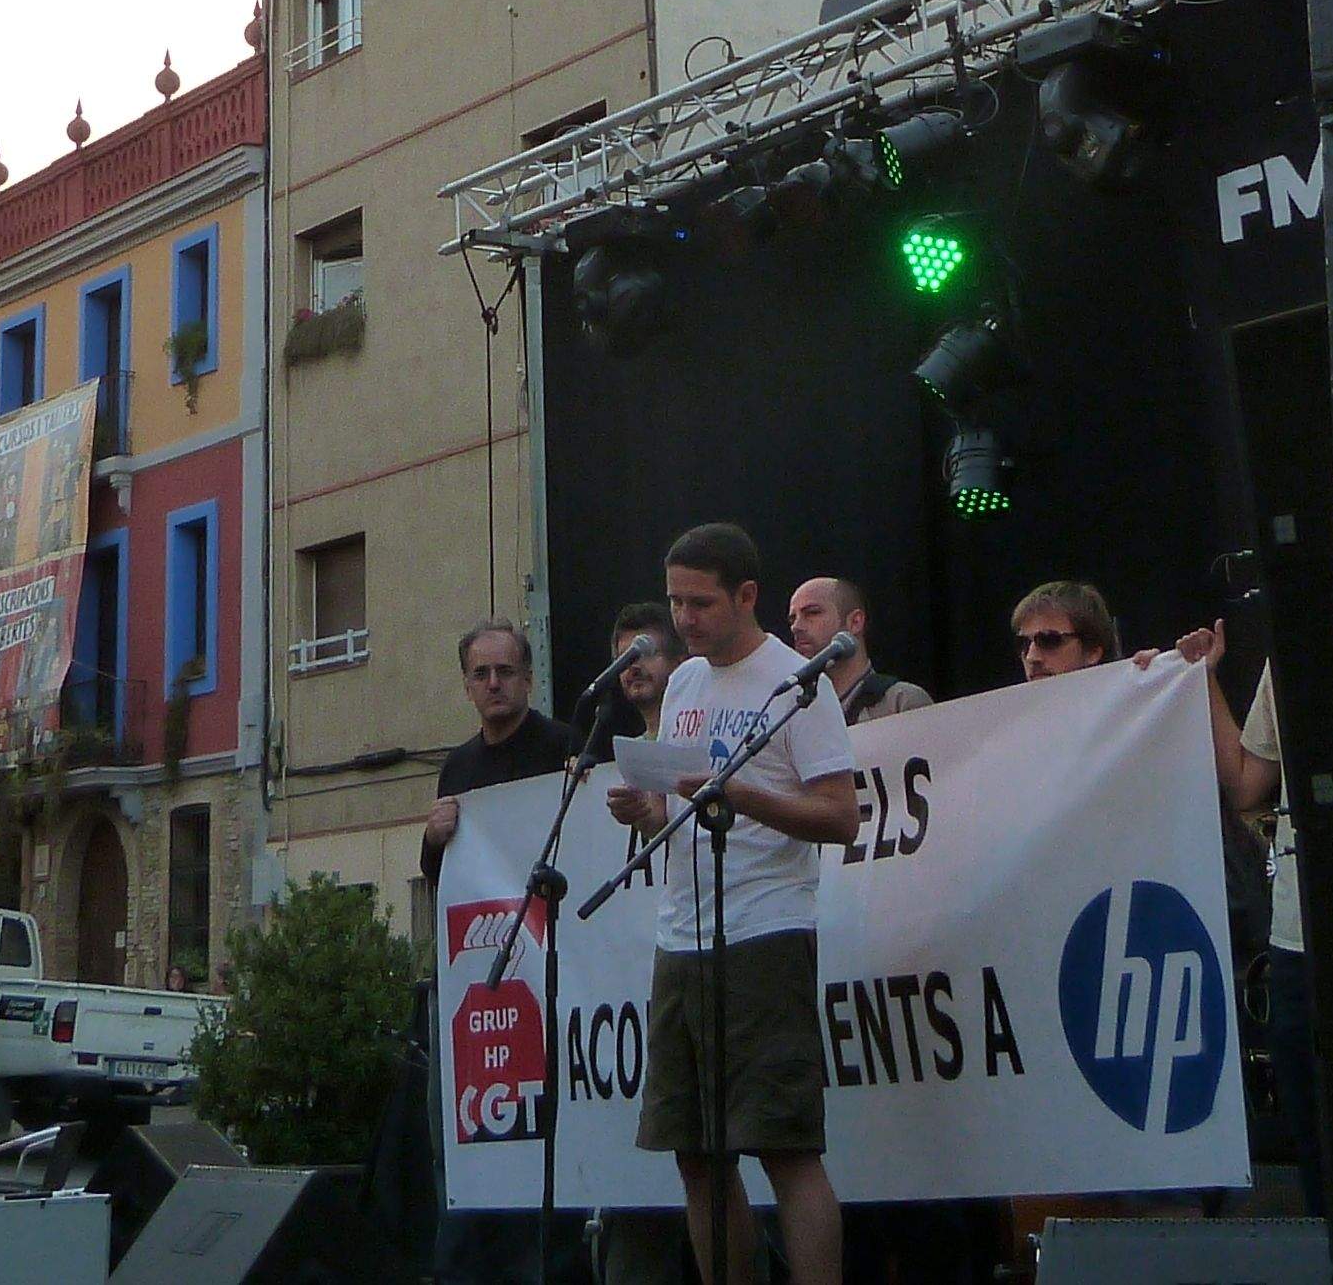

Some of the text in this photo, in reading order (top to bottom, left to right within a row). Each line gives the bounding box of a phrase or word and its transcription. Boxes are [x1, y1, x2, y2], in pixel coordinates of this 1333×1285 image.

[672, 708, 705, 738] STOP
[469, 1008, 518, 1033] GRUP
[986, 965, 1025, 1078] A
[1095, 880, 1203, 1133] hp
[484, 1045, 510, 1068] HP
[459, 1079, 544, 1136] CGT
